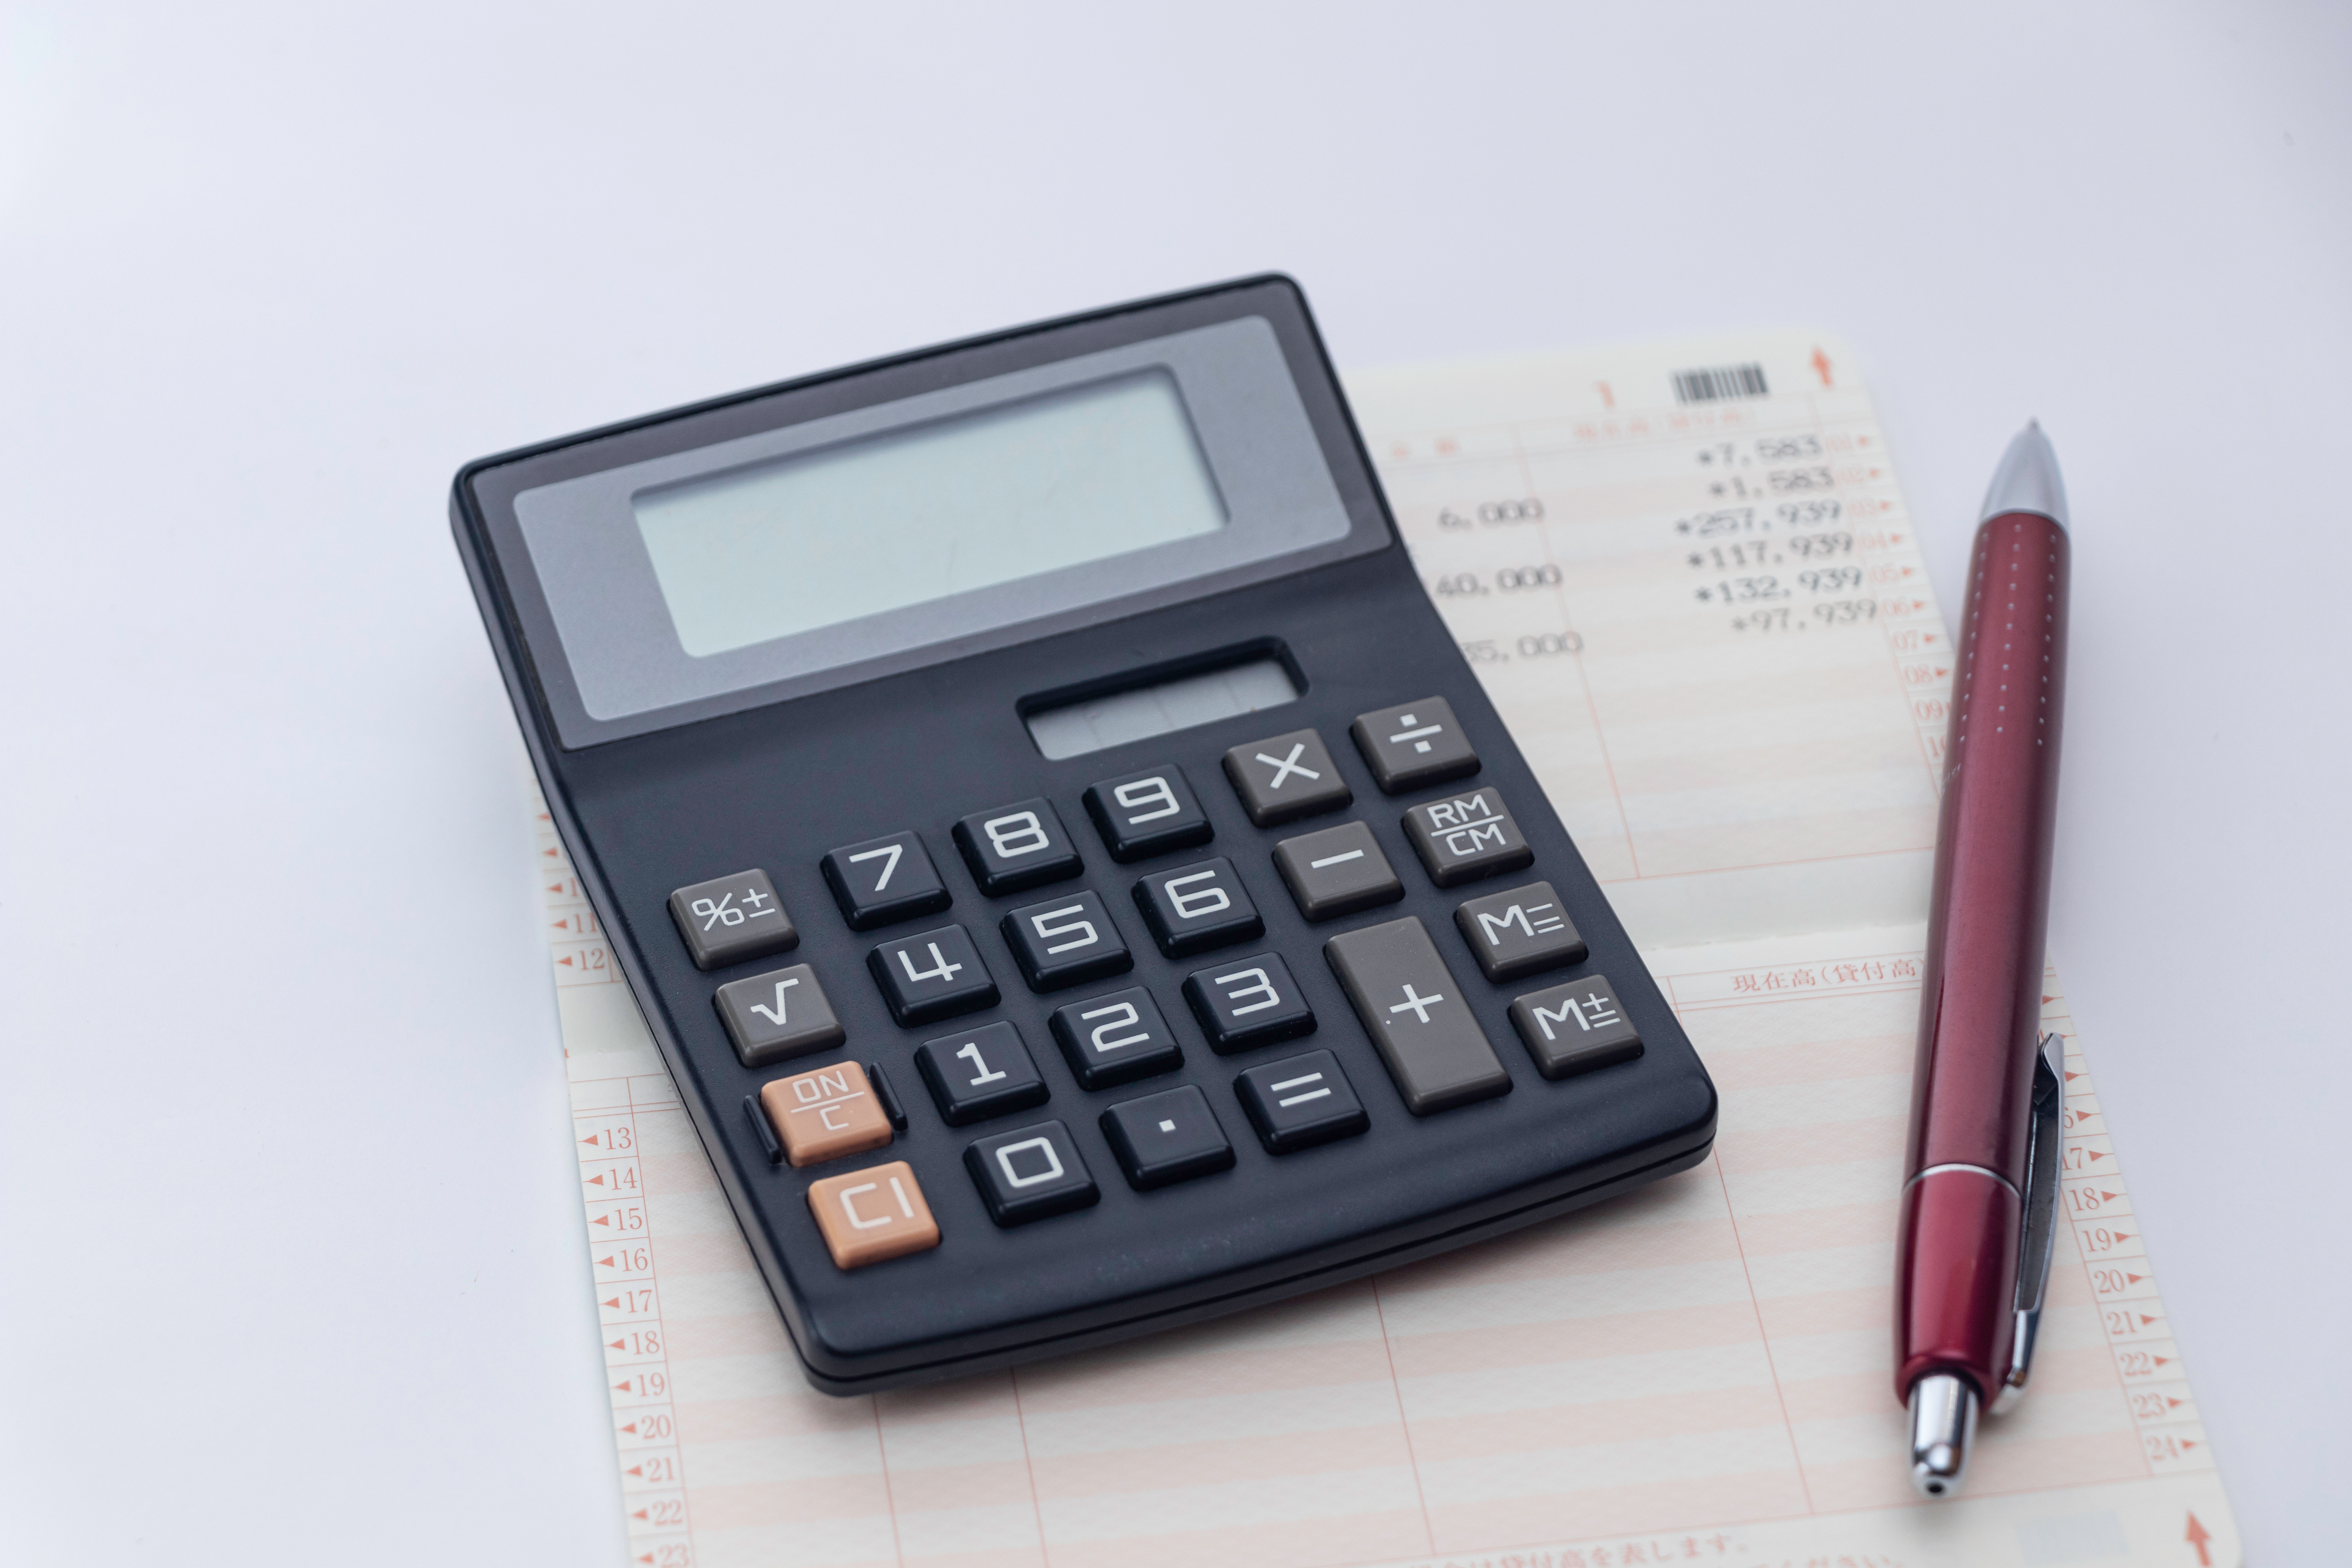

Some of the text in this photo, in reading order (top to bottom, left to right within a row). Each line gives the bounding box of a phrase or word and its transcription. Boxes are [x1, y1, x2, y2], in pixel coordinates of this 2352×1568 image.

[1891, 628, 1918, 651] 07
[1904, 664, 1933, 686] 08
[1915, 698, 1944, 722] 09
[1390, 714, 1441, 752] ÷
[1114, 777, 1180, 824] 9
[1427, 794, 1492, 828] RM
[984, 811, 1049, 857] 8
[1445, 824, 1506, 856] CM
[849, 844, 902, 891] 7
[1165, 871, 1230, 918] 6
[1031, 905, 1098, 954] 5
[579, 948, 605, 971] 12
[898, 943, 962, 982] 4
[751, 978, 799, 1025] √
[1215, 968, 1279, 1016] 3
[1390, 984, 1444, 1023] +
[1082, 1002, 1149, 1052] 2
[957, 1043, 1006, 1085] 1
[792, 1070, 850, 1103] ON
[1271, 1073, 1330, 1107] =
[820, 1105, 849, 1130] C
[2064, 1107, 2074, 1129] 6
[604, 1127, 632, 1150] 13
[996, 1137, 1063, 1187] 0
[609, 1167, 636, 1190] 14
[2070, 1187, 2100, 1211] 18
[615, 1207, 642, 1230] 15
[2082, 1229, 2111, 1252] 19
[620, 1248, 648, 1272] 16
[2094, 1270, 2125, 1294] 20
[626, 1289, 652, 1313] 17
[2107, 1311, 2136, 1336] 21
[631, 1331, 660, 1355] 18
[2120, 1351, 2153, 1376] 22
[637, 1373, 665, 1397] 19
[2132, 1392, 2167, 1419] 23
[641, 1415, 671, 1439] 20
[2146, 1435, 2179, 1461] 24
[647, 1457, 674, 1483] 21
[653, 1500, 683, 1526] 22
[658, 1544, 690, 1568] 23
